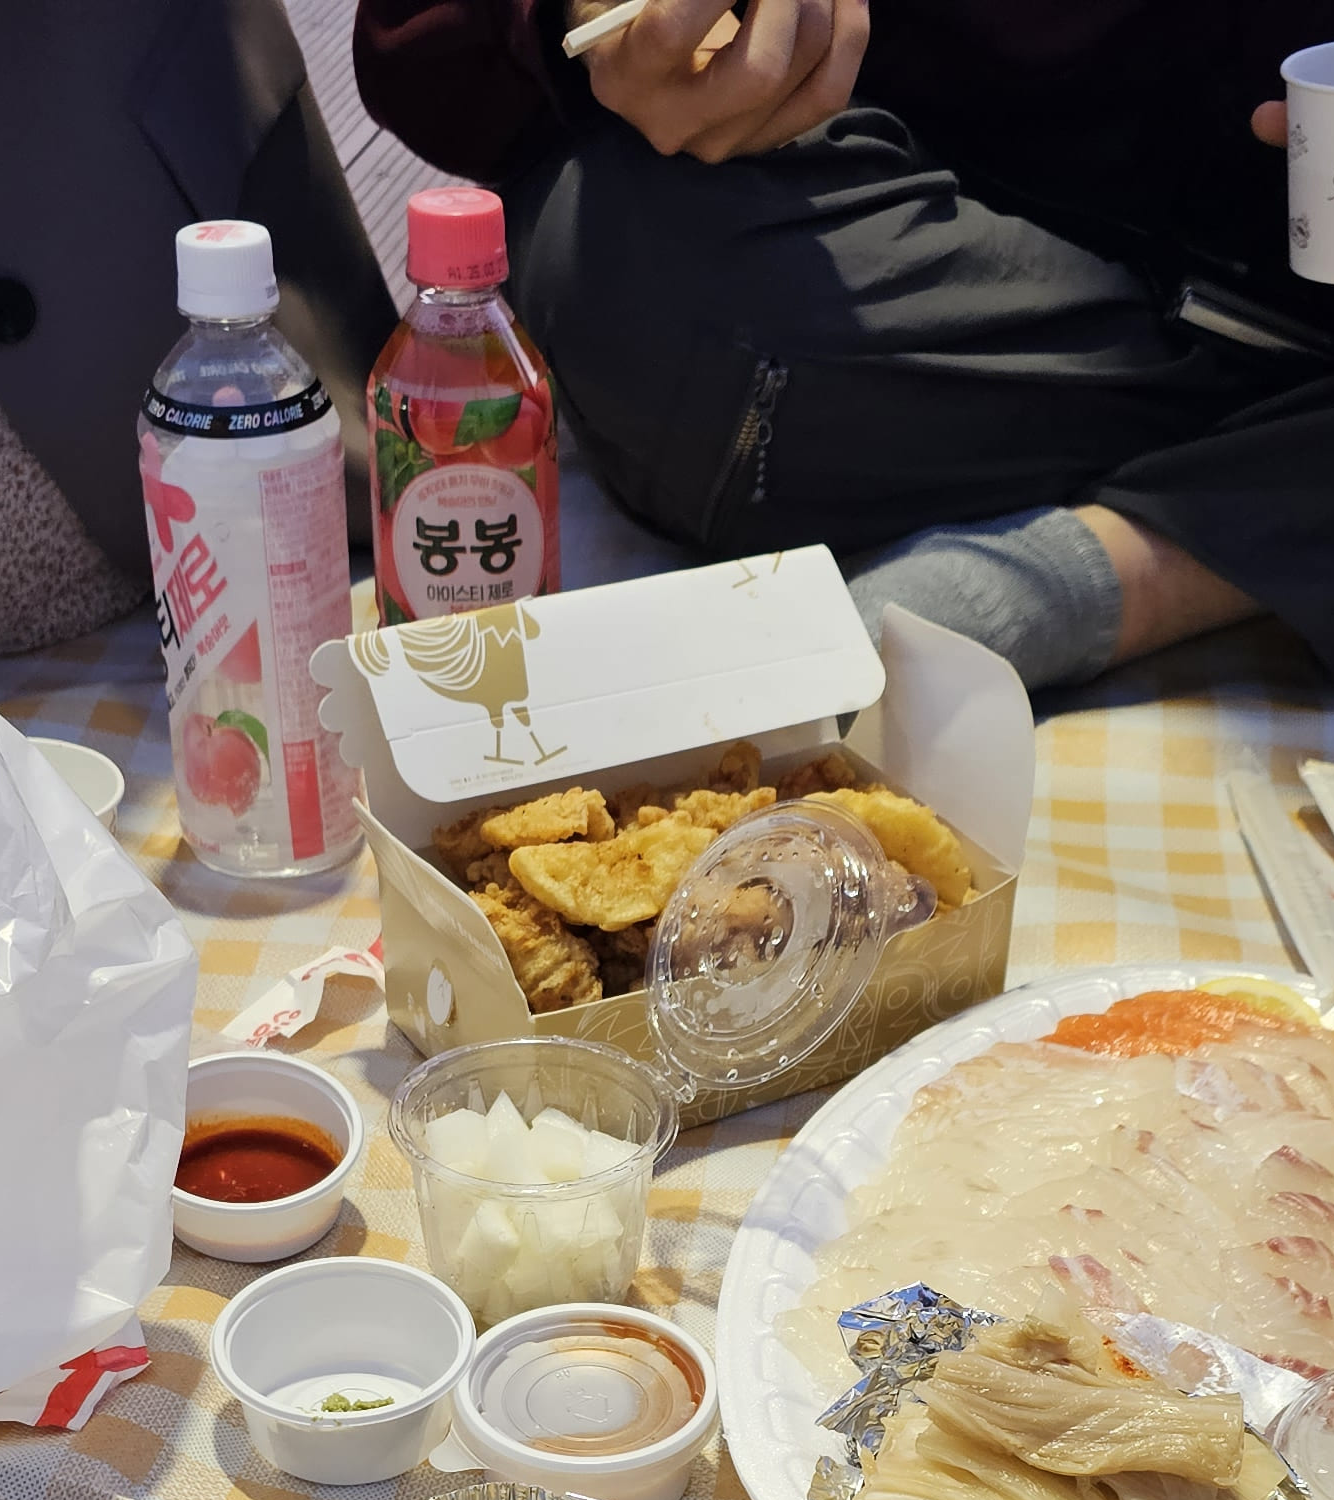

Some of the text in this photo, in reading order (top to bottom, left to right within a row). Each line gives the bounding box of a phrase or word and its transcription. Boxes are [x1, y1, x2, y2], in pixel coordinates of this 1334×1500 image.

[166, 407, 214, 430] CALORIE
[227, 402, 305, 431] ZERO CALORIE
[412, 513, 523, 576] 봉봉
[426, 580, 515, 603] 아이스티 제로
